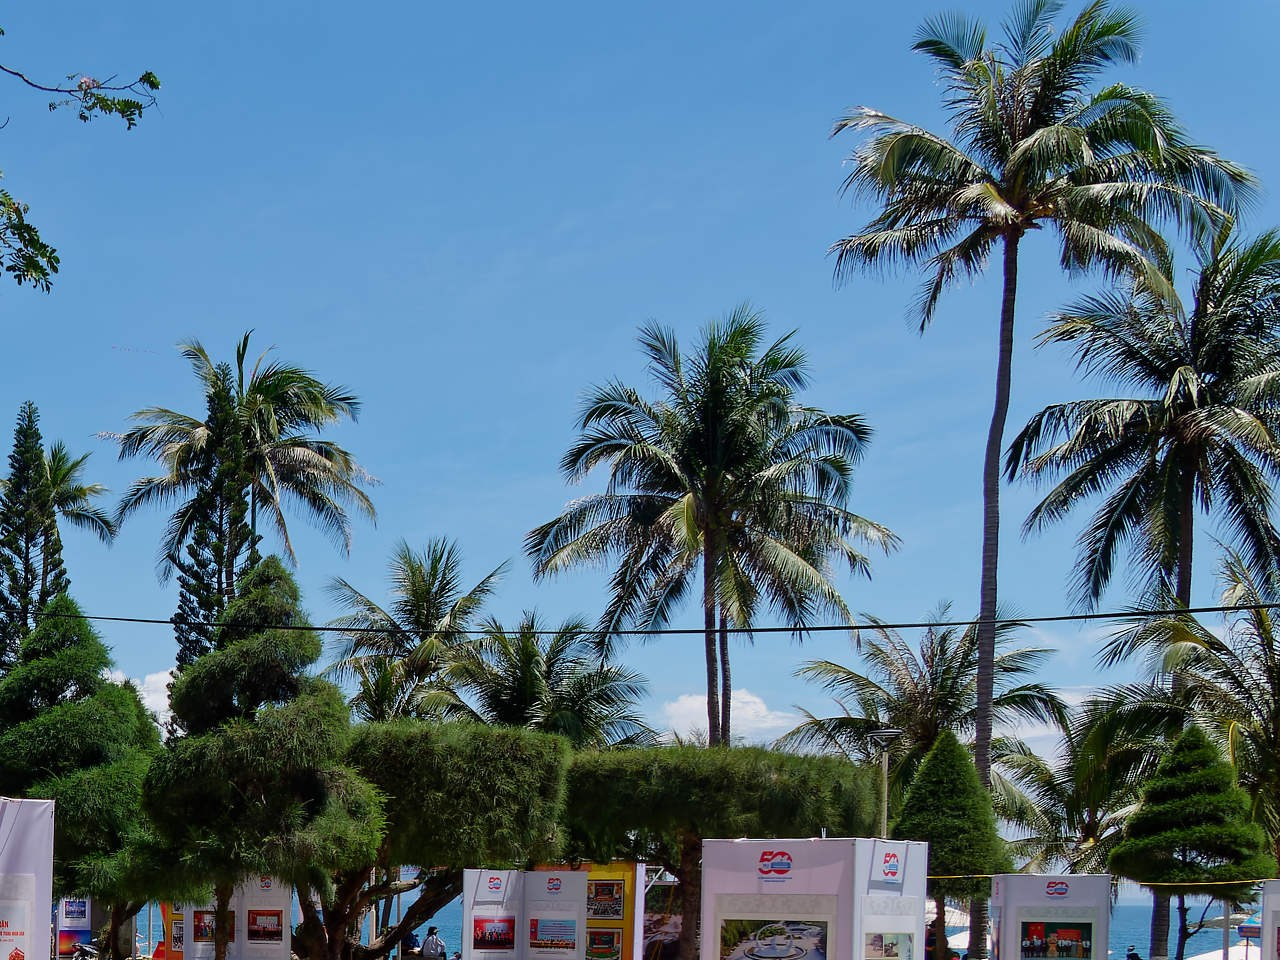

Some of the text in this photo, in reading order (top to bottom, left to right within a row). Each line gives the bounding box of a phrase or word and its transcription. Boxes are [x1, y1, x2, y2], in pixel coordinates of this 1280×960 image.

[758, 851, 792, 874] 50
[883, 853, 899, 876] 50
[1046, 881, 1069, 895] 50
